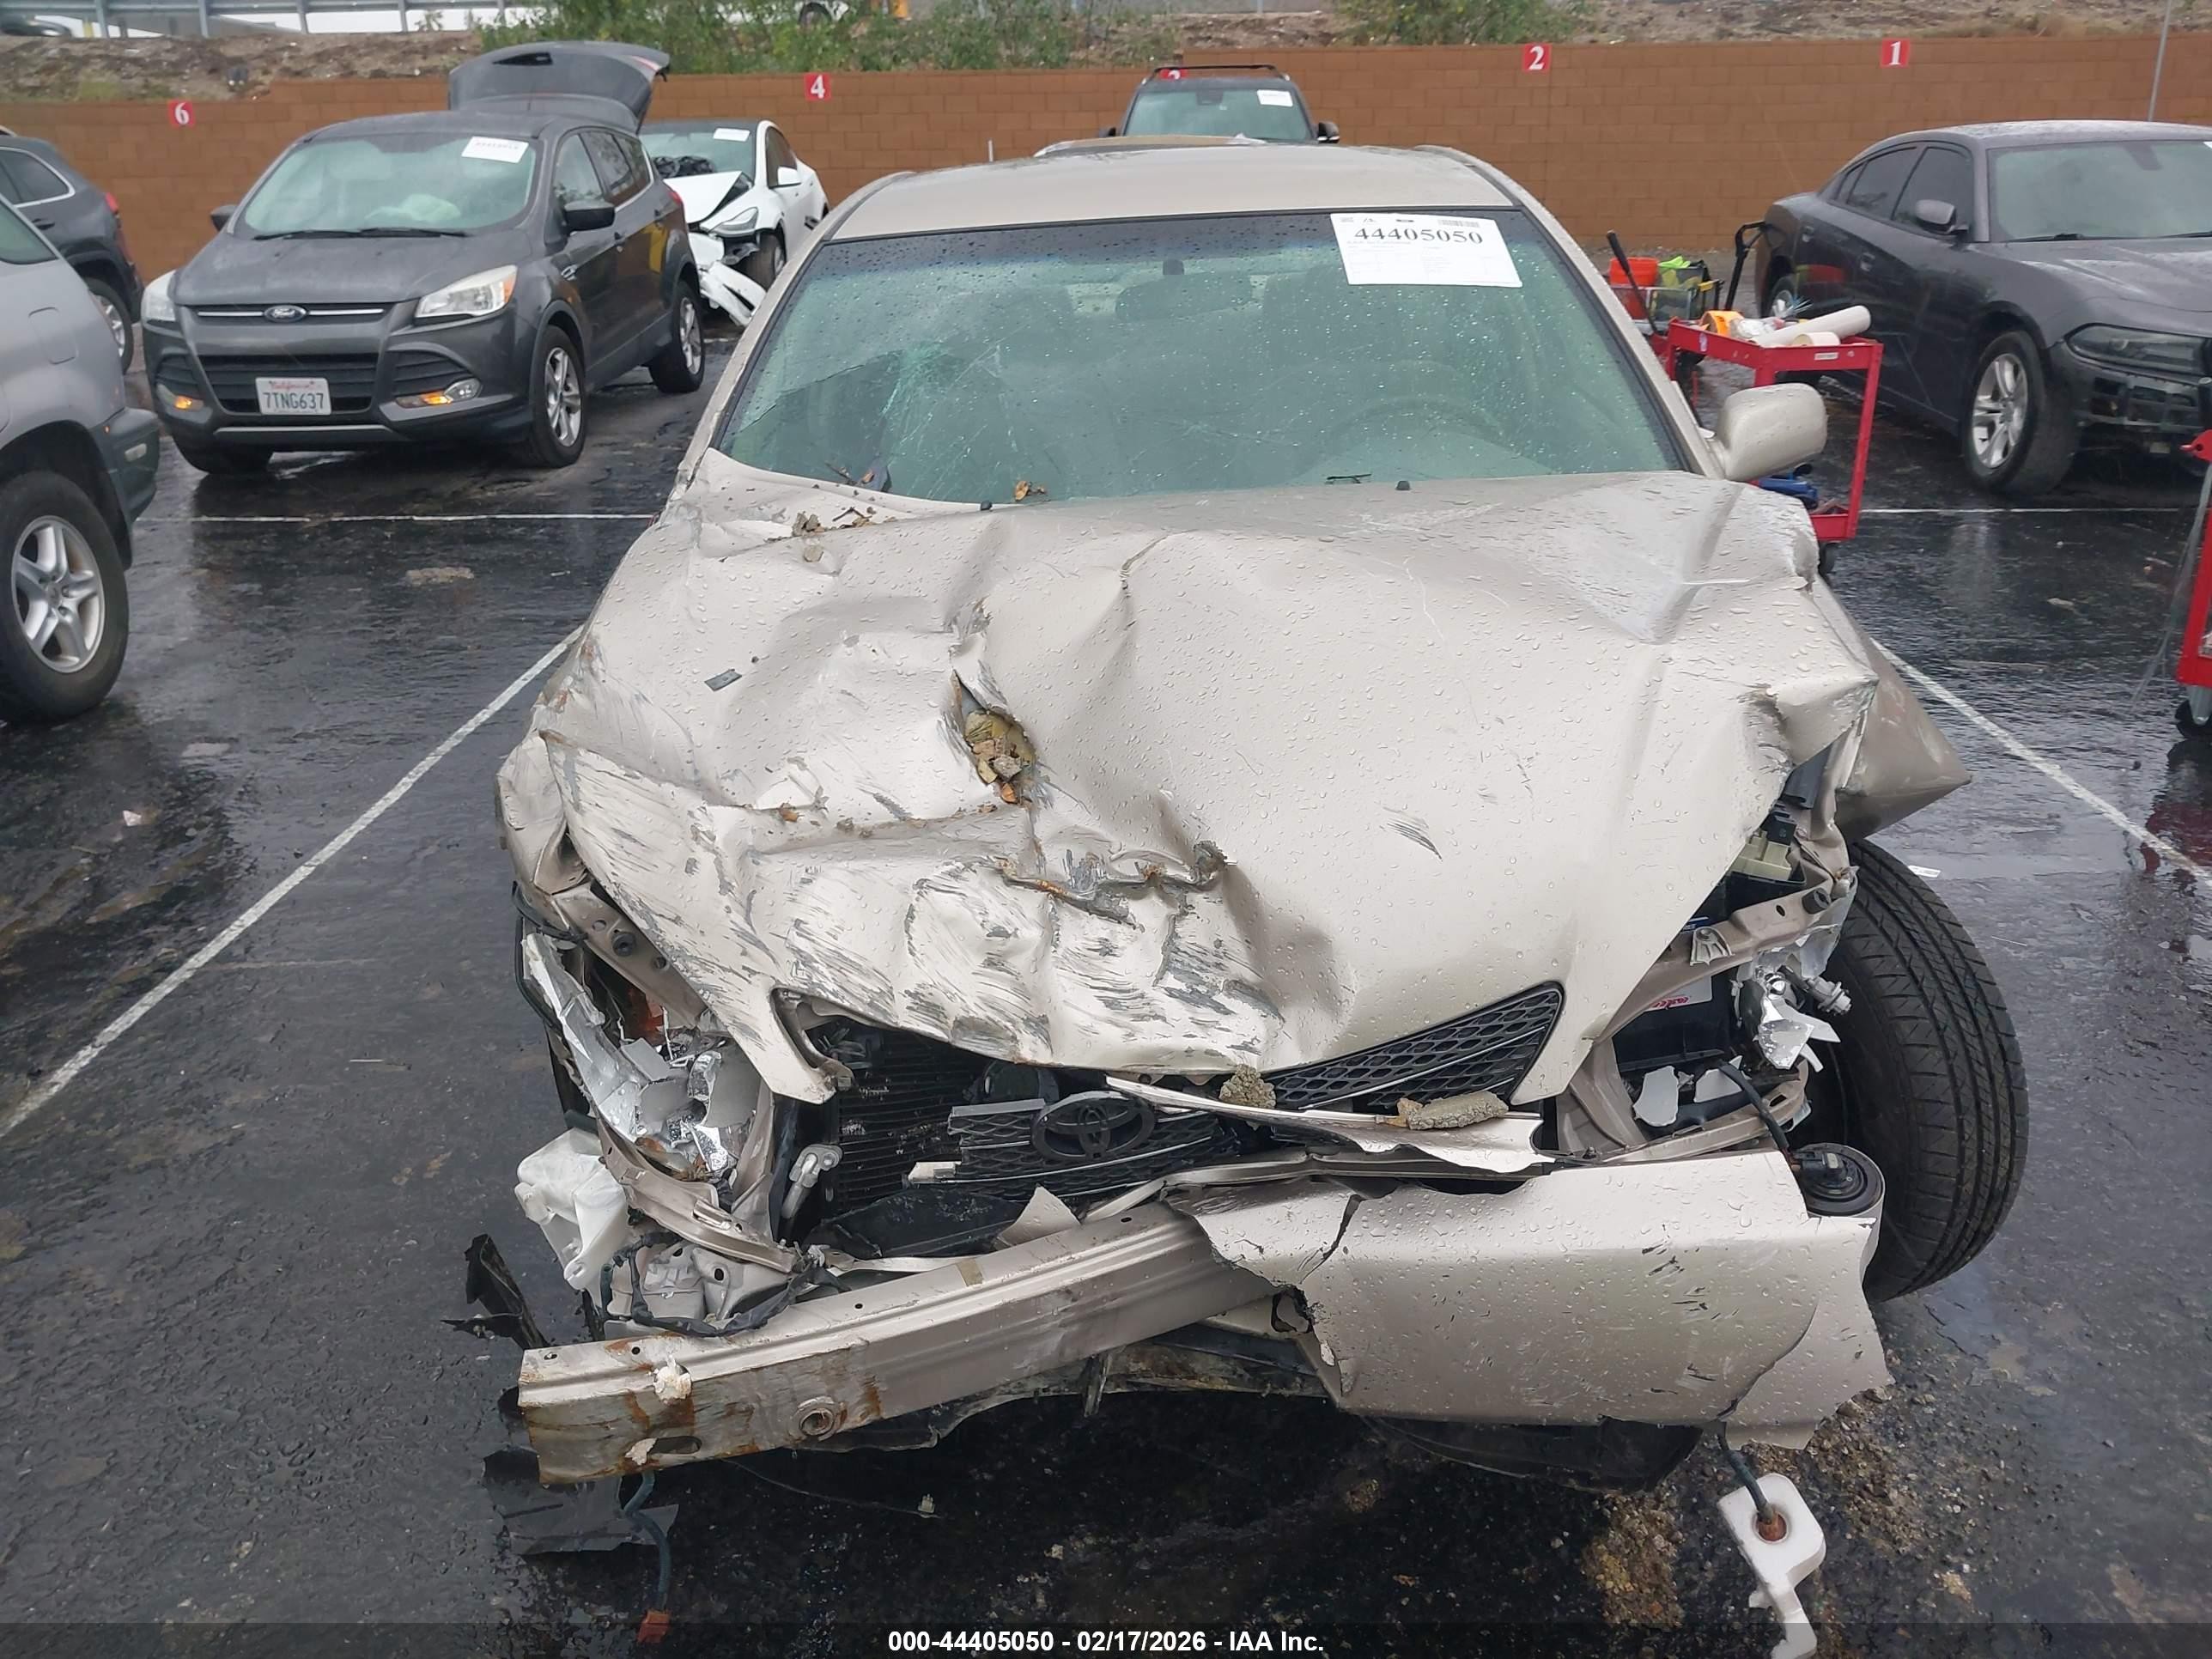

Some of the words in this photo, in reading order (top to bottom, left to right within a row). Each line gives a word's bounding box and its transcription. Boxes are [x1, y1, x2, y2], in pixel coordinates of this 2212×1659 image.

[1528, 46, 1545, 70] 2
[1889, 40, 1901, 65] 1
[810, 75, 825, 99] 4
[174, 101, 189, 125] 6
[1354, 228, 1483, 245] 44405050
[263, 392, 325, 410] 7TNG637
